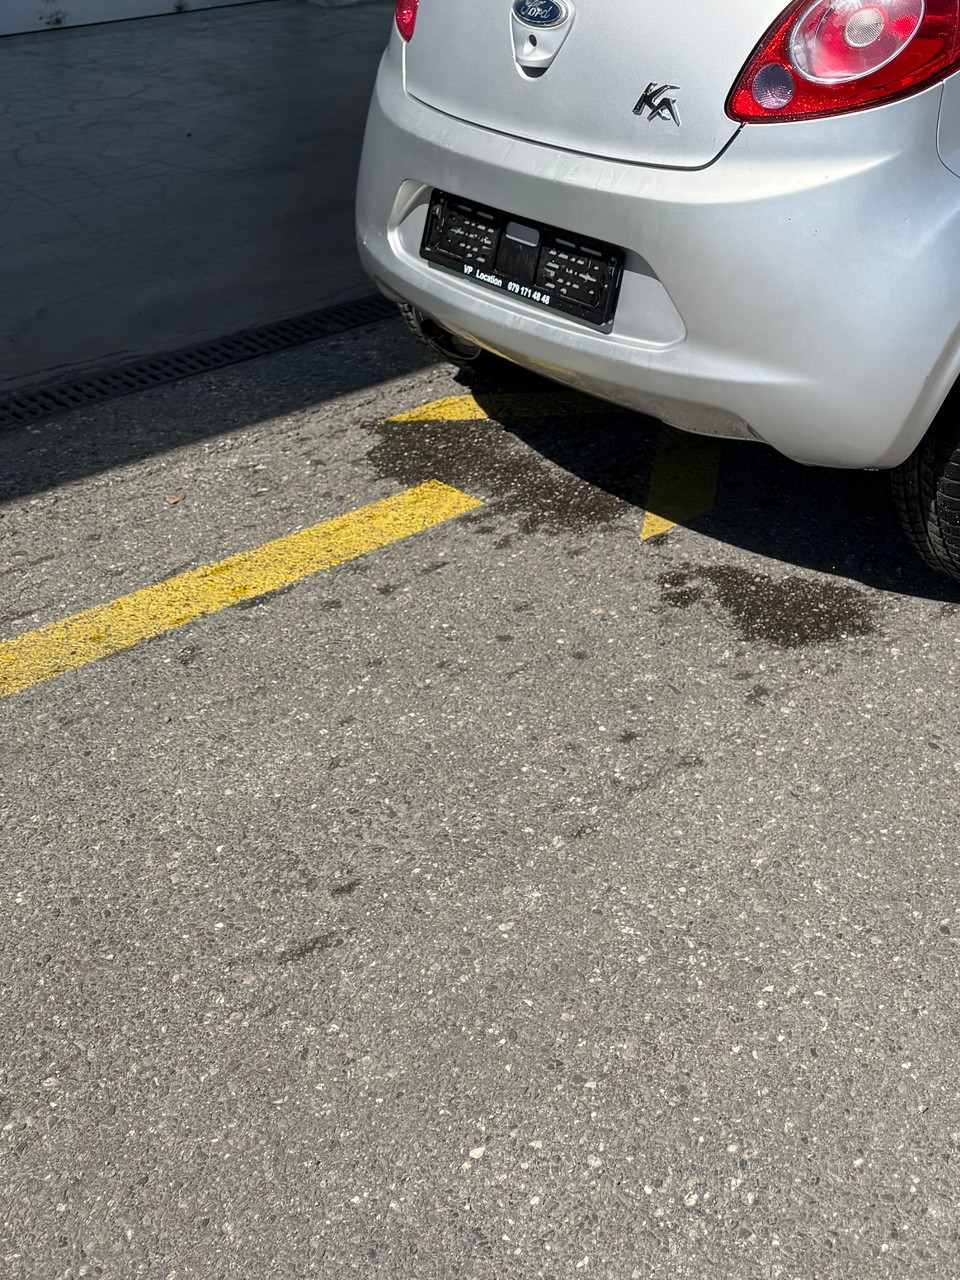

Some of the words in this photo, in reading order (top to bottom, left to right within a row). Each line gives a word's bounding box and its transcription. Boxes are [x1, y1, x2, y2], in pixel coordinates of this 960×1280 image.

[463, 264, 473, 275] VP
[475, 269, 503, 287] Location
[507, 281, 520, 293] 079
[520, 286, 532, 298] 171
